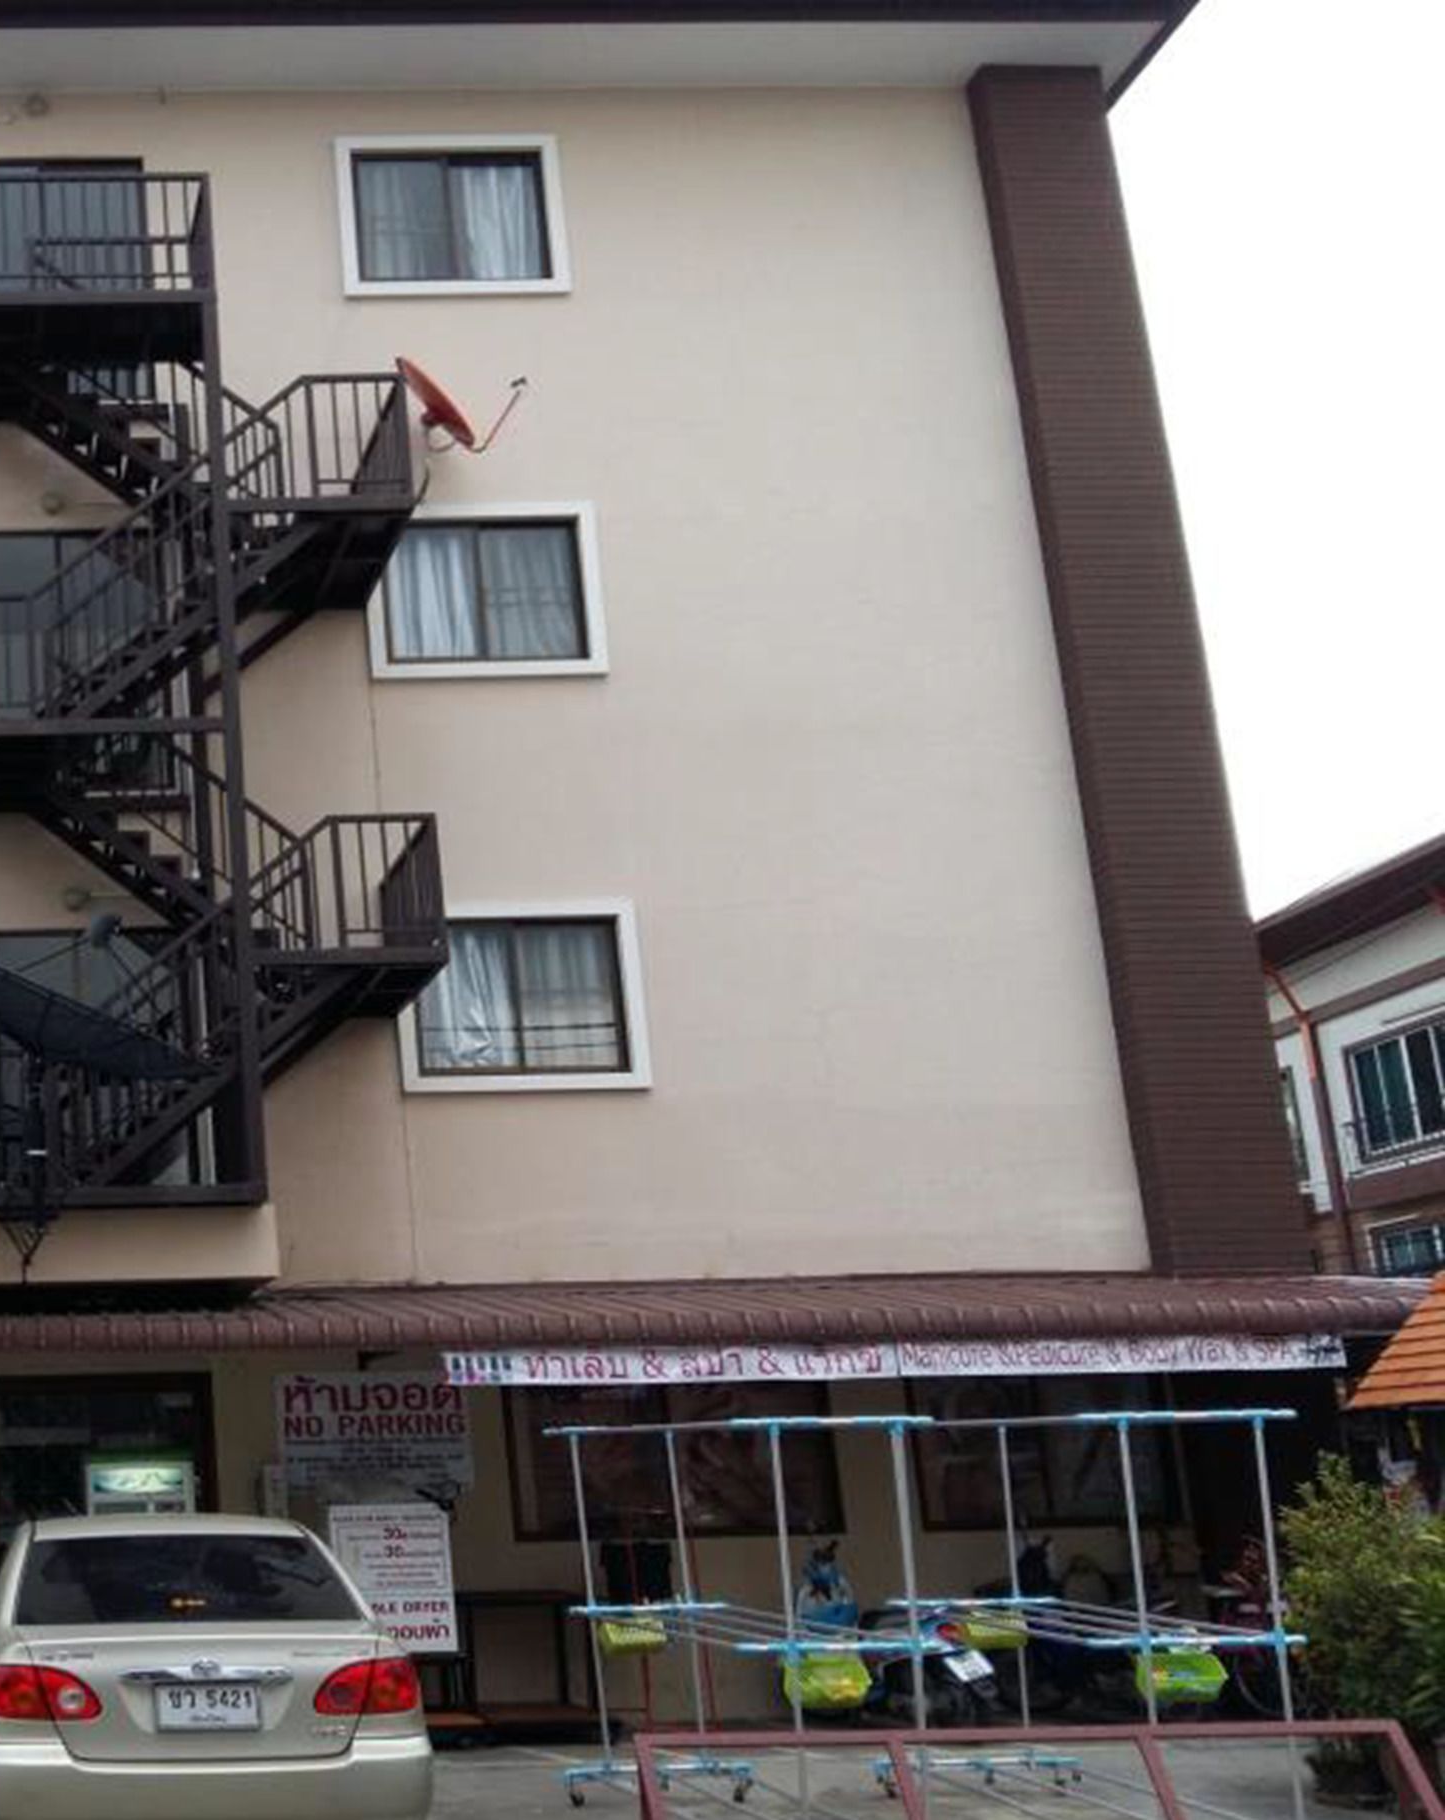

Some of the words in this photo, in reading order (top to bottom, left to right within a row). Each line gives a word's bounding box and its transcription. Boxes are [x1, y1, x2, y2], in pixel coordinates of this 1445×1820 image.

[642, 1349, 668, 1379] &
[758, 1344, 785, 1376] &
[284, 1374, 463, 1414] ห้ามจอด
[284, 1415, 324, 1438] NO
[338, 1412, 466, 1437] PARKING
[205, 1688, 253, 1710] 5421
